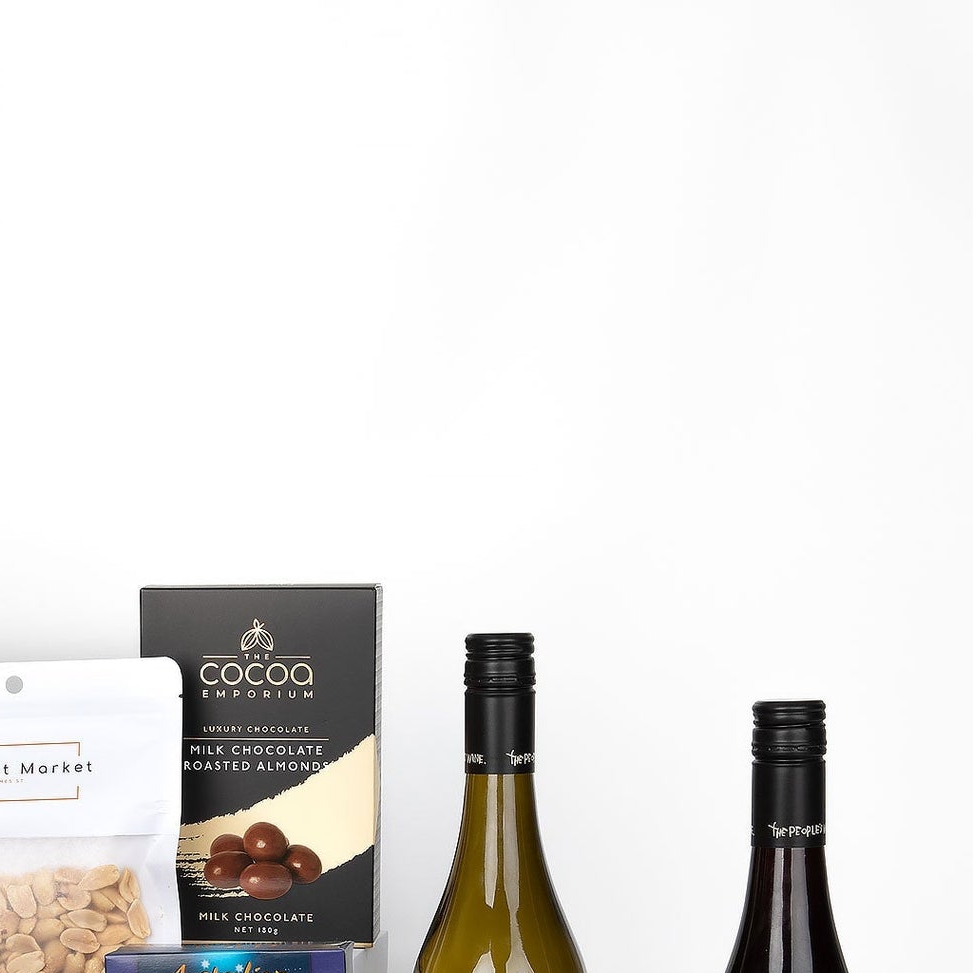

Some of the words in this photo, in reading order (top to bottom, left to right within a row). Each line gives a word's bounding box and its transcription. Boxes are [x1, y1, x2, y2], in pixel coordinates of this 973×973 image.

[202, 690, 314, 699] EMPORIUM
[190, 745, 225, 755] MILK
[231, 745, 323, 755] CHOCOLATE
[20, 761, 93, 775] Market
[183, 760, 251, 771] ROASTED
[256, 761, 329, 772] ALMONDS
[199, 912, 229, 922] MILK
[234, 912, 314, 923] CHOCOLATE
[234, 926, 253, 934] NET
